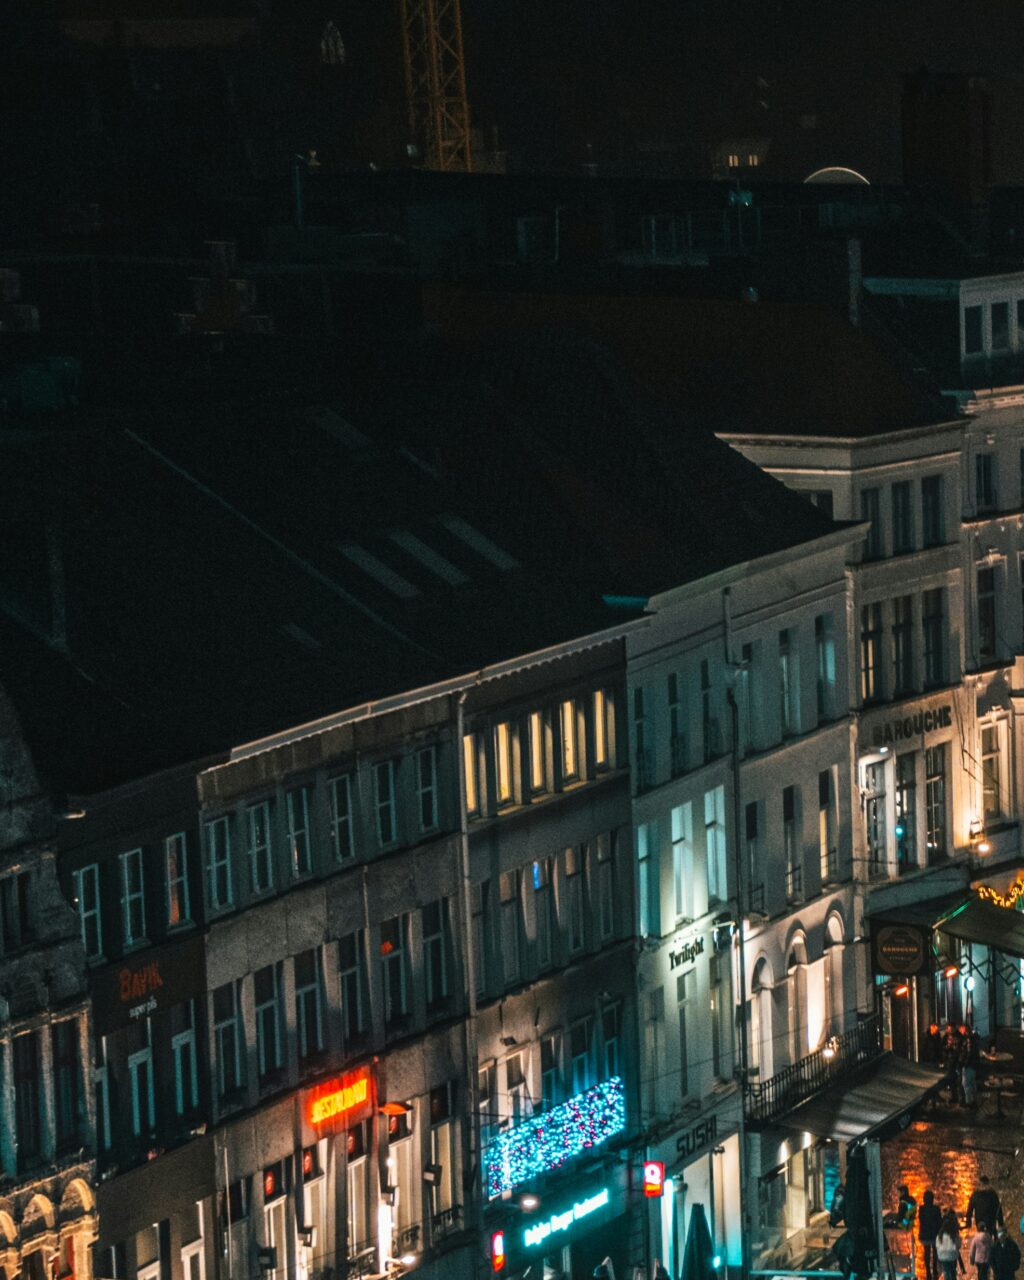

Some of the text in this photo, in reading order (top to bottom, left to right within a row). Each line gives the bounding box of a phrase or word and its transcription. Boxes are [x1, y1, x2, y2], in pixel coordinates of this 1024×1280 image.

[873, 705, 952, 746] BAROUCHE
[669, 936, 704, 971] Twilight
[676, 1115, 717, 1158] SUSHI
